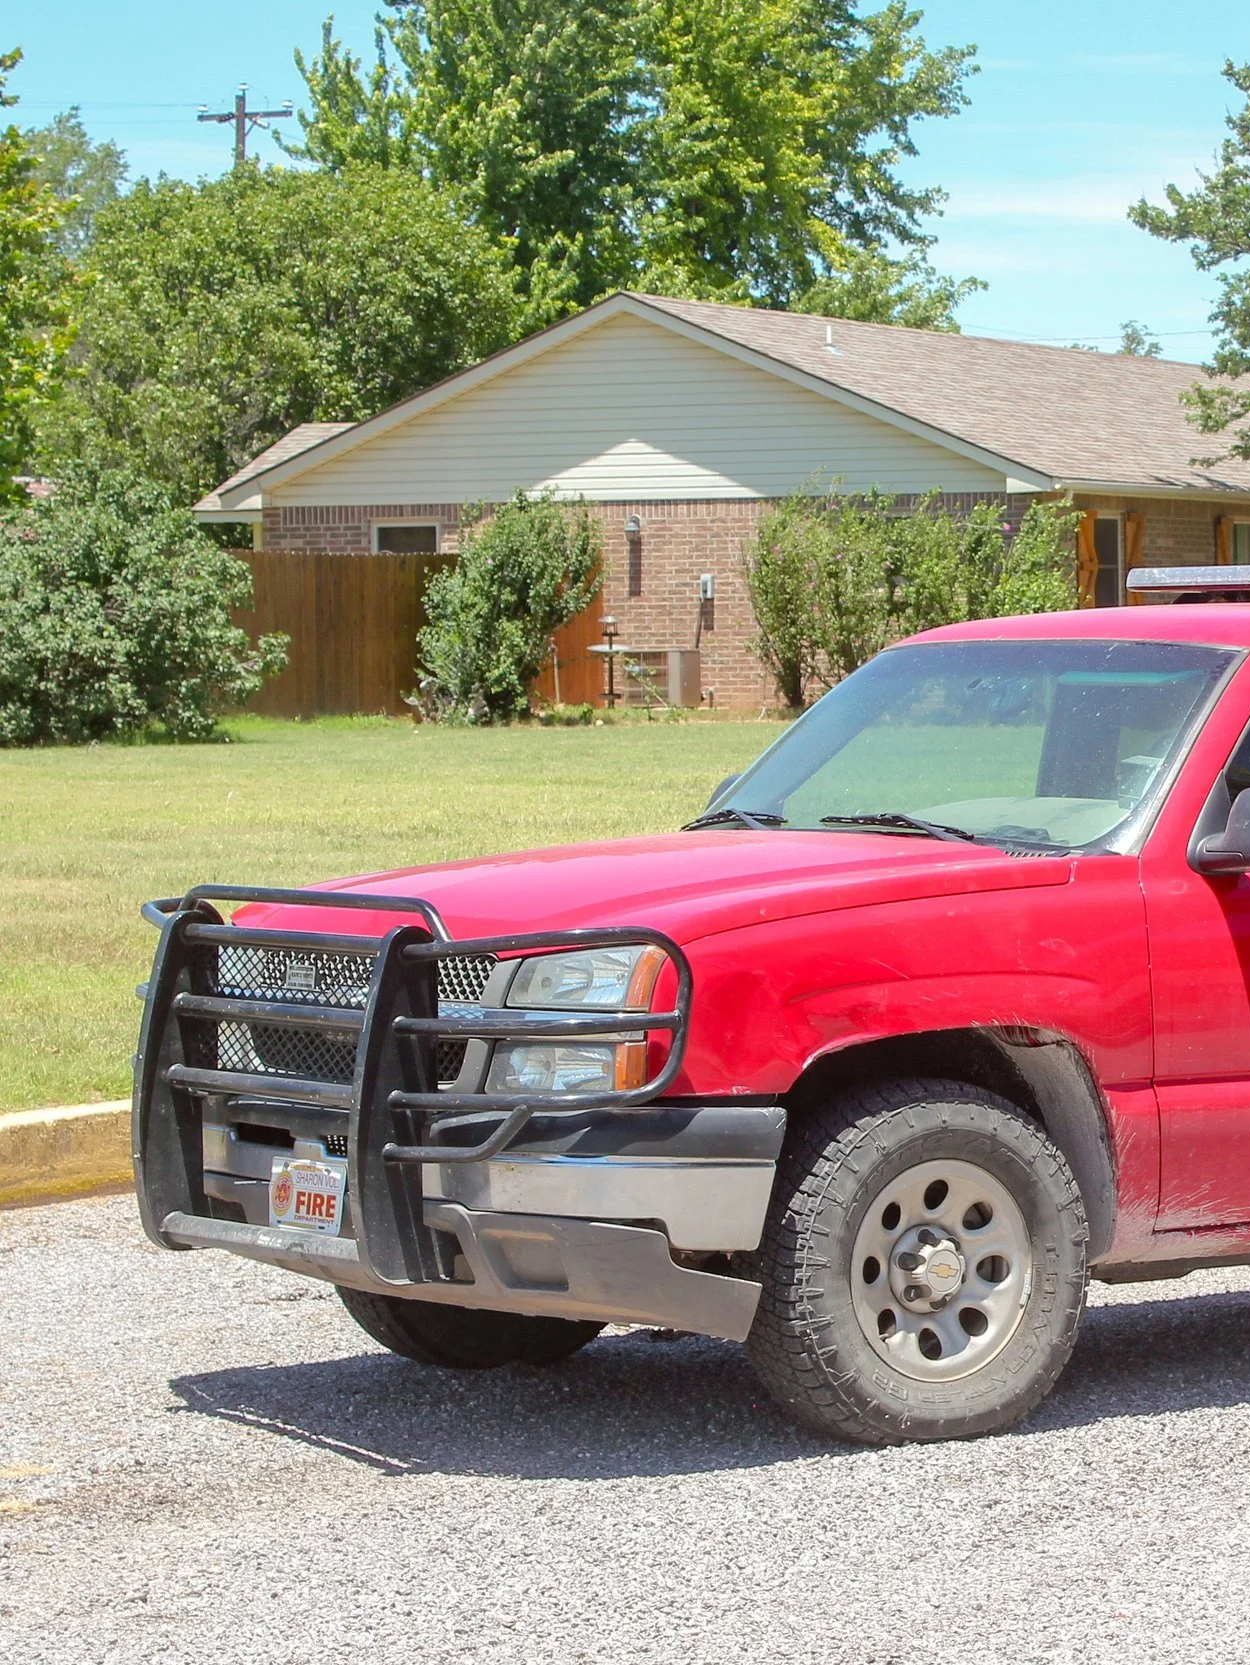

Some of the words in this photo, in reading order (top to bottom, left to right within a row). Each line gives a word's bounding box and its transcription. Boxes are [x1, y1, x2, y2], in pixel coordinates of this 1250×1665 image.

[296, 1172, 324, 1186] SHARON
[295, 1191, 336, 1218] FIRE
[294, 1215, 334, 1224] DEPARTMENT
